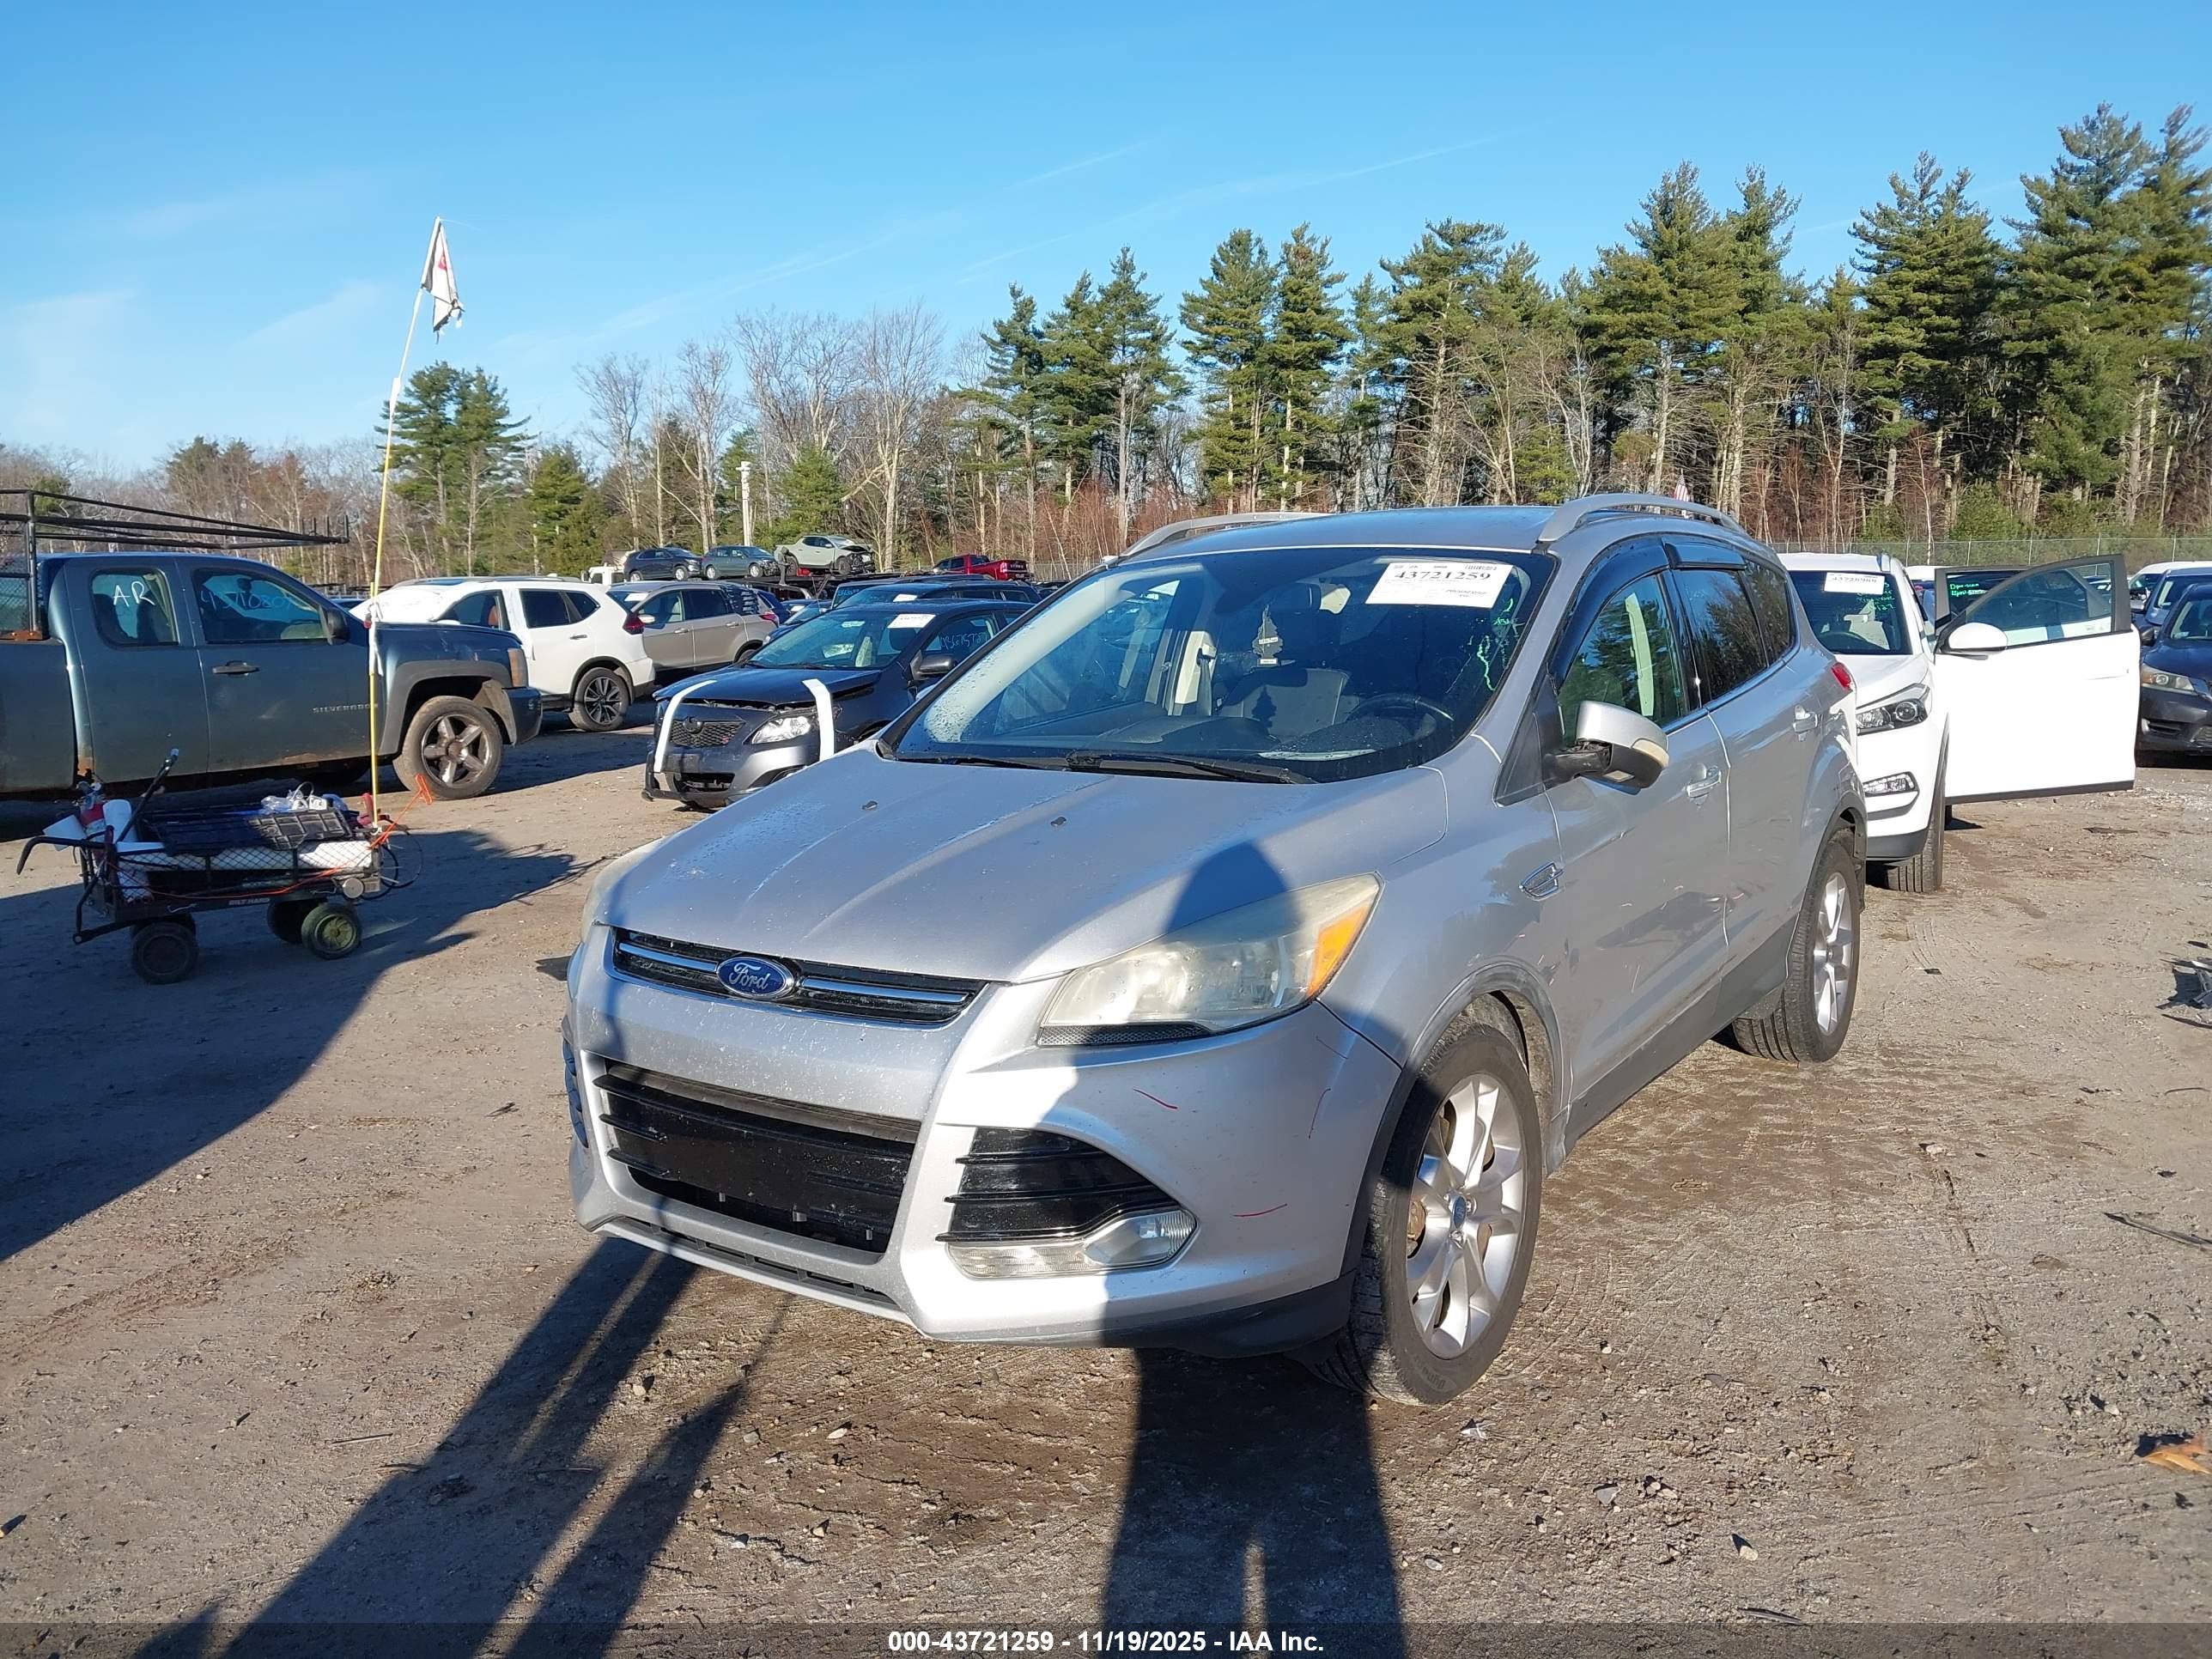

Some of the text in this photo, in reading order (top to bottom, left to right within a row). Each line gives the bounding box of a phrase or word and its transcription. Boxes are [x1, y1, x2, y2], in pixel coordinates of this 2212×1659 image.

[1394, 570, 1491, 580] 43721259
[113, 580, 155, 607] AR
[728, 962, 771, 990] Ford
